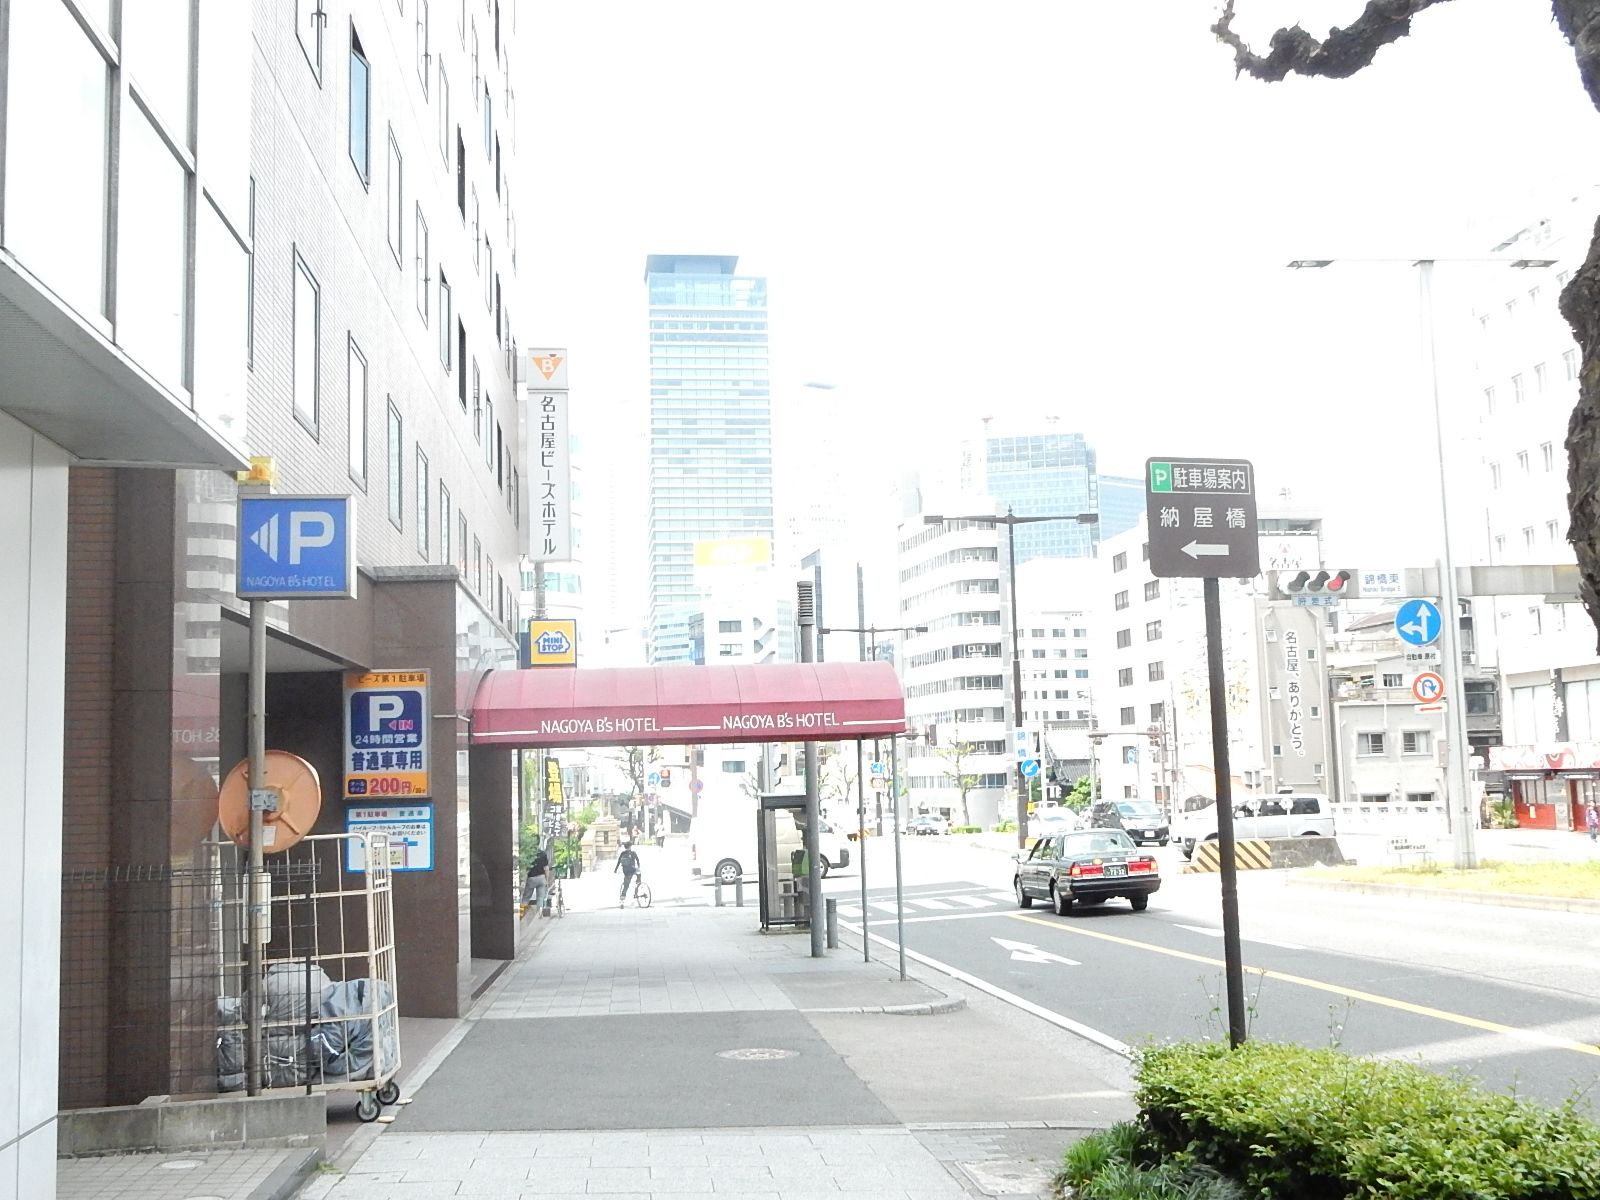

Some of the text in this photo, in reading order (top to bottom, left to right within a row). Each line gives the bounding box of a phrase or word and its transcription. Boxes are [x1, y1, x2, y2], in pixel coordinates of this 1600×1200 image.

[540, 395, 557, 555] 名古屋ビーズホテル
[1155, 468, 1168, 486] P
[1173, 467, 1246, 490] 駐車場案内
[1159, 506, 1247, 529] 納屋橋
[289, 511, 335, 565] P
[246, 574, 337, 587] NAGOYA B's HOTEL
[369, 695, 404, 732] P
[722, 712, 840, 730] NAGOYA B's HOTEL
[398, 719, 414, 731] IN
[541, 717, 661, 734] NAGOYA B's HOTEL
[355, 734, 418, 745] 24時間営業
[351, 750, 423, 771] 普通車専用
[369, 778, 412, 794] 200円
